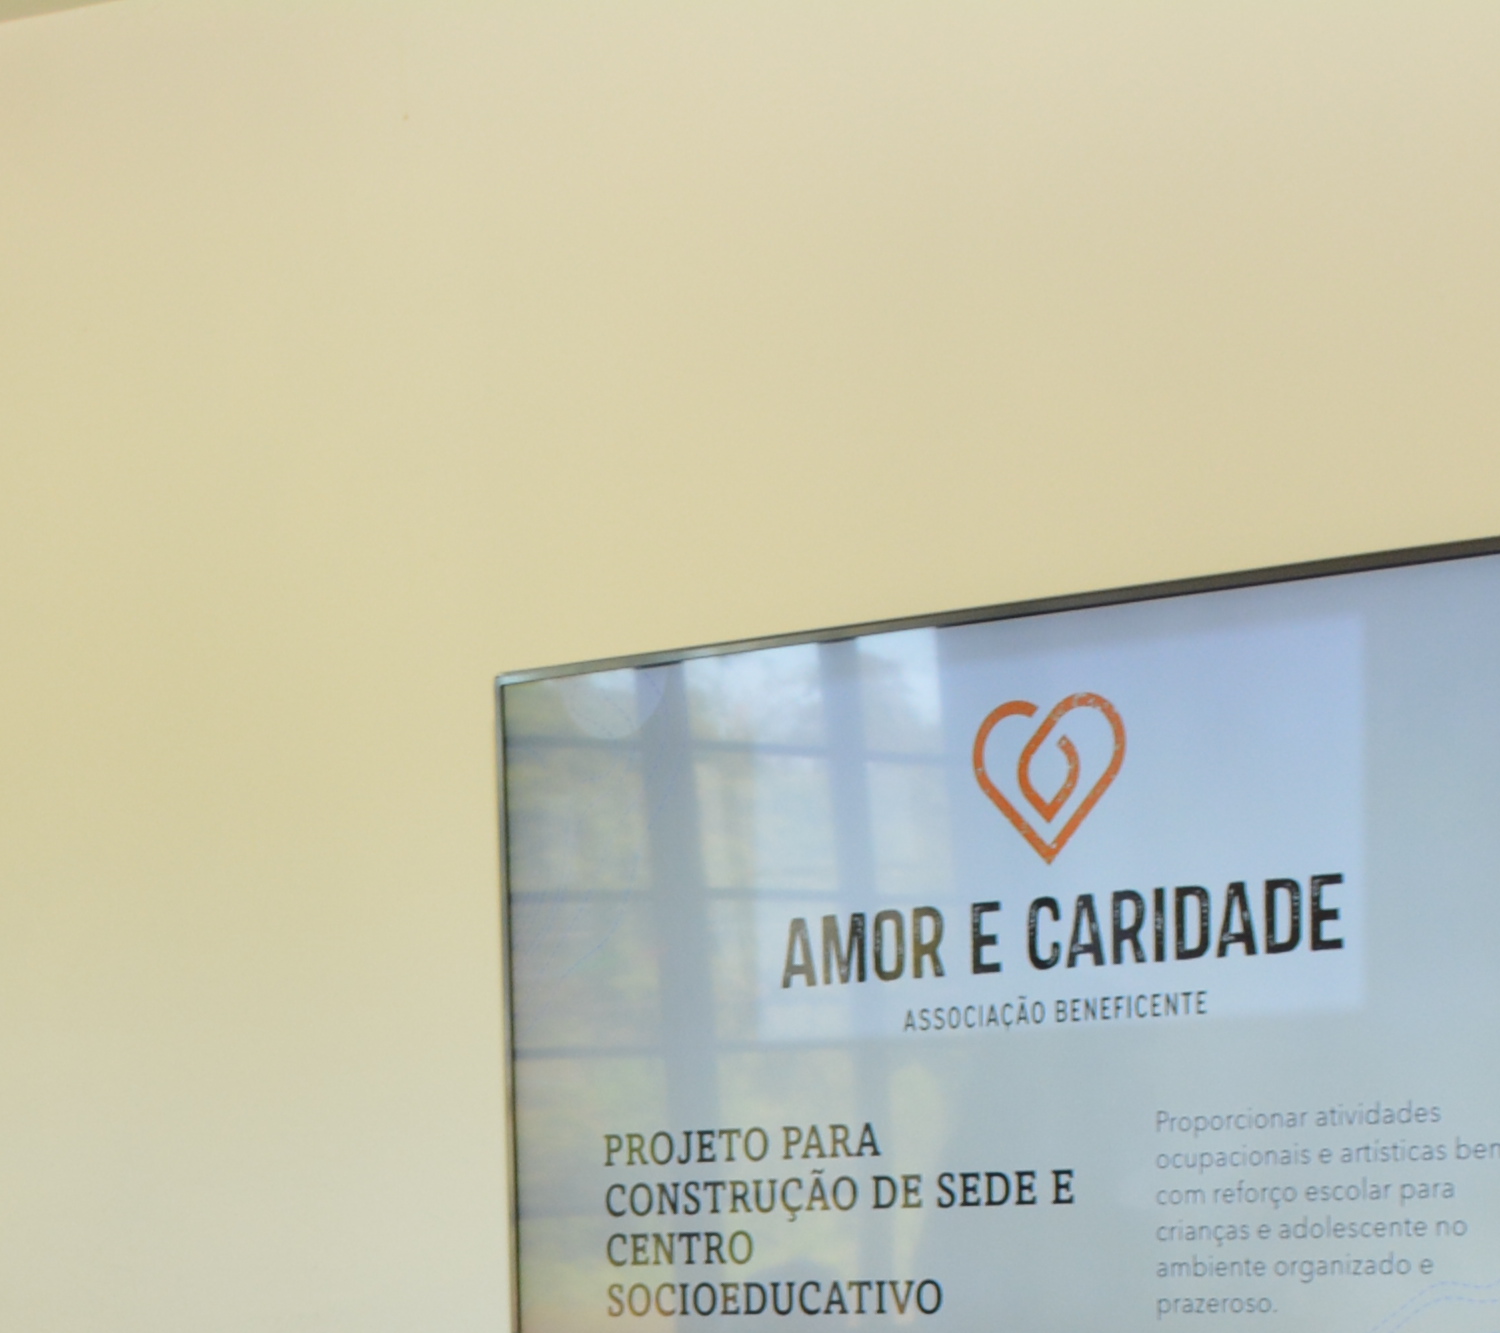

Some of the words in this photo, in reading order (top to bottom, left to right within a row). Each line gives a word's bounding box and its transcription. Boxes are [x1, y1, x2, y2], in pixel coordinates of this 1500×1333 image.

[781, 906, 946, 989] AMOR
[971, 900, 1003, 975] E
[1026, 872, 1345, 971] CARIDADE
[903, 995, 1046, 1033] ASSOCIAÇÃO
[1055, 991, 1209, 1024] BENEFICENTE
[1155, 1107, 1308, 1139] Proporcionar
[1315, 1101, 1442, 1128] atividades
[603, 1127, 770, 1167] PROJETO
[782, 1122, 882, 1160] PARA
[1155, 1143, 1312, 1174] ocupacionais
[1317, 1145, 1334, 1165] e
[1339, 1138, 1448, 1164] artísticas
[605, 1169, 859, 1222] CONSTRUÇÃO
[872, 1174, 923, 1209] DE
[936, 1170, 1037, 1209] SEDE
[1051, 1169, 1075, 1205] E
[1155, 1185, 1206, 1206] com
[1213, 1179, 1298, 1210] reforço
[1304, 1177, 1394, 1202] escolar
[1400, 1181, 1457, 1207] para
[606, 1230, 754, 1267] CENTRO
[1155, 1219, 1250, 1246] crianças
[1257, 1222, 1272, 1240] e
[1278, 1215, 1428, 1240] adolescente
[1435, 1217, 1469, 1237] no
[1155, 1254, 1267, 1278] ambiente
[1274, 1252, 1412, 1283] organizado
[1418, 1256, 1435, 1275] e
[607, 1279, 943, 1317] SOCIOEDUCATIVO
[1156, 1294, 1278, 1320] prazeroso.
